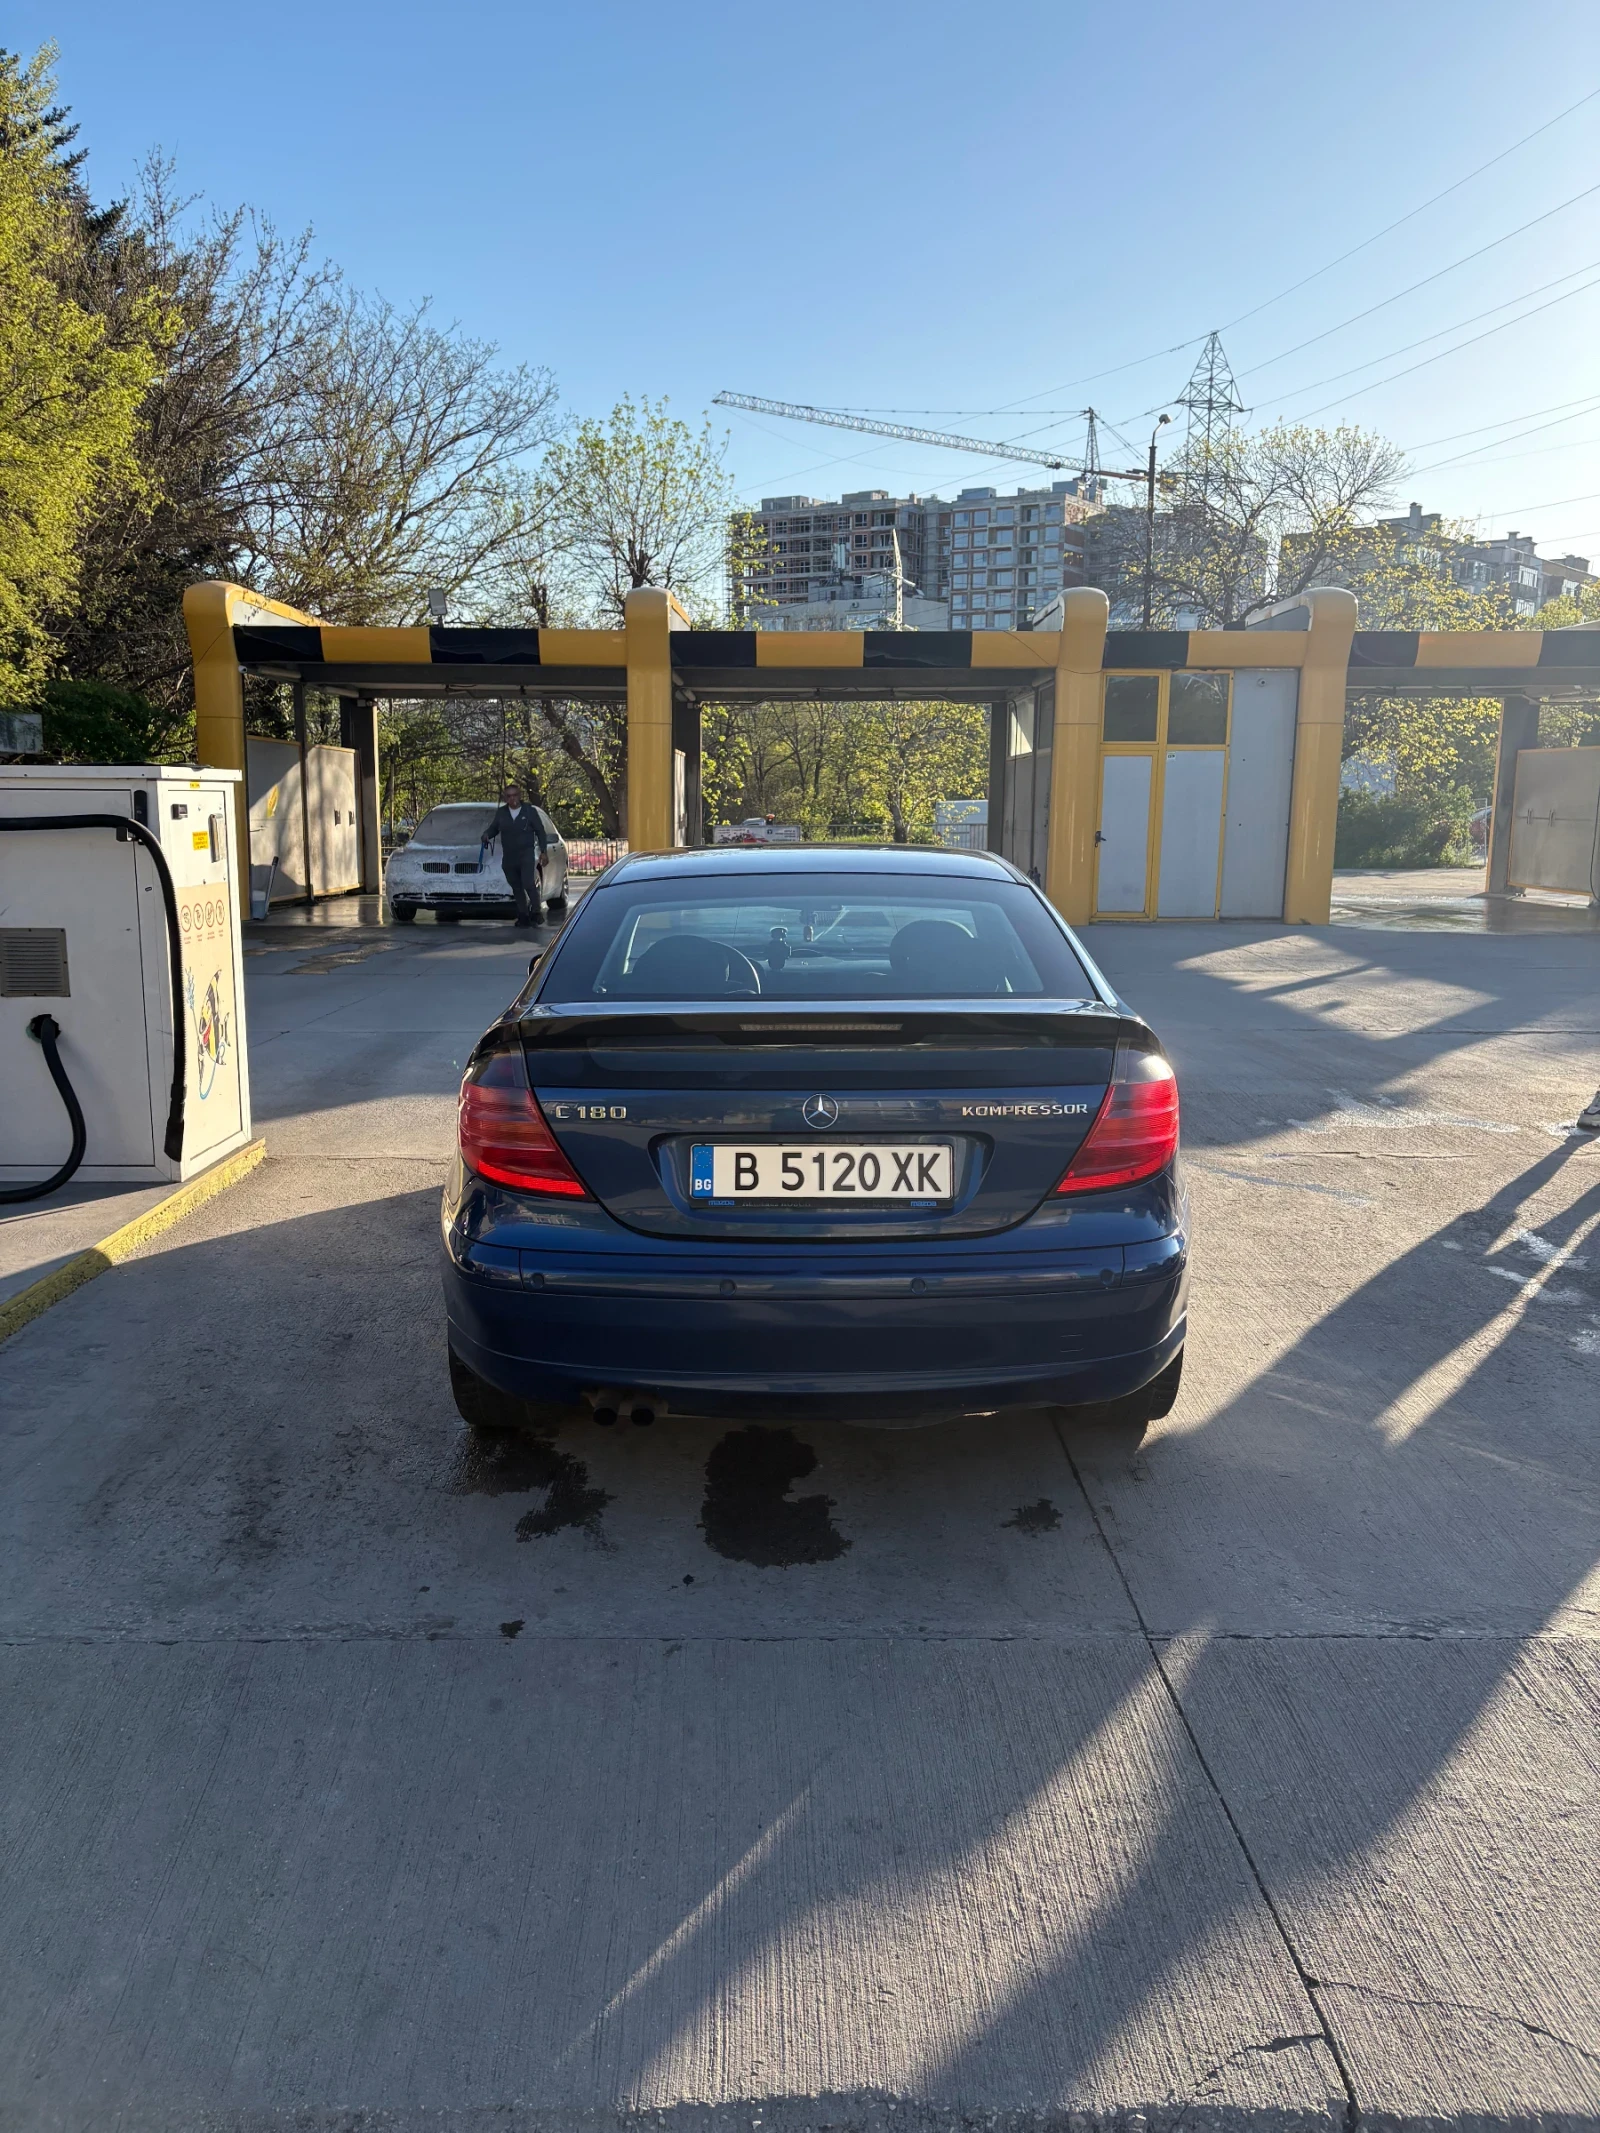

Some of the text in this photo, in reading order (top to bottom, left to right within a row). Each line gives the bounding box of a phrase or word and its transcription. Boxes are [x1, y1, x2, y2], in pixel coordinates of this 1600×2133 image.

[555, 1105, 627, 1119] C 180
[962, 1103, 1088, 1117] KOMPRESSOR
[734, 1152, 942, 1192] B 5120 XK
[694, 1178, 712, 1191] BG
